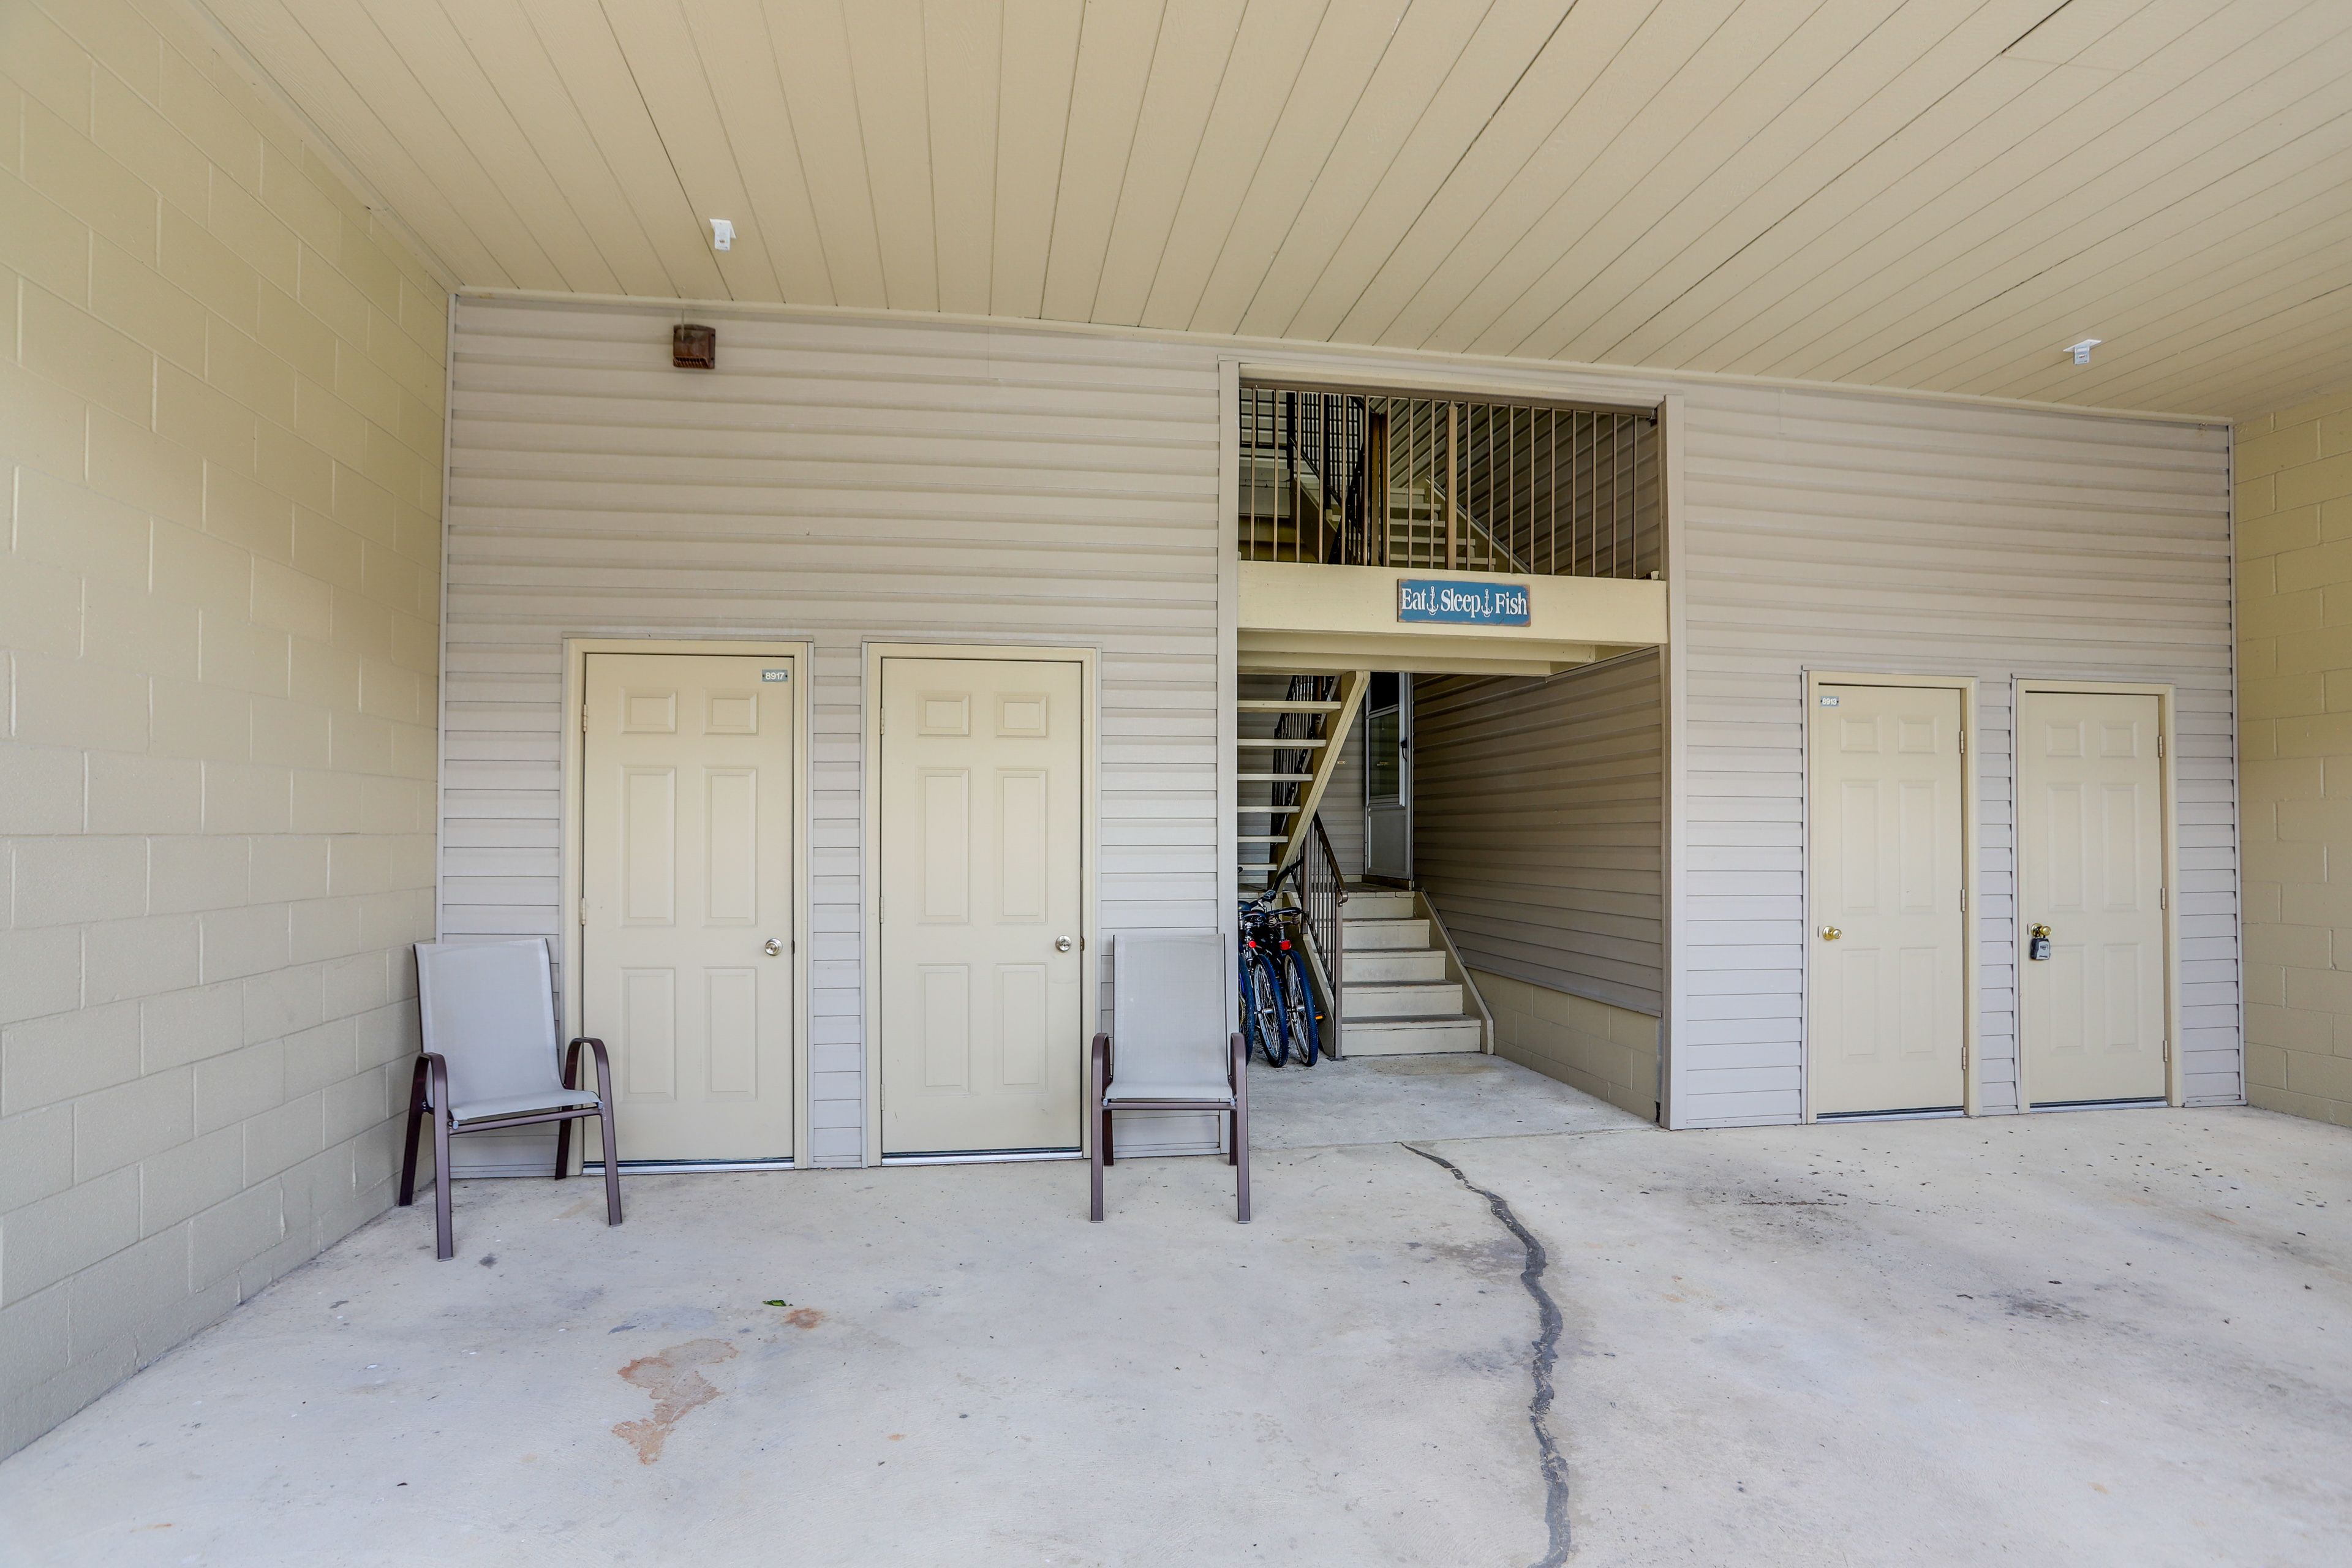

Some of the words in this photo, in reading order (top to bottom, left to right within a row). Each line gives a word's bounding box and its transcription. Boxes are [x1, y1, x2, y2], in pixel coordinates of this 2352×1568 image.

[1401, 588, 1426, 610] Eat
[1441, 588, 1481, 618] Sleep
[1495, 591, 1528, 616] Fish
